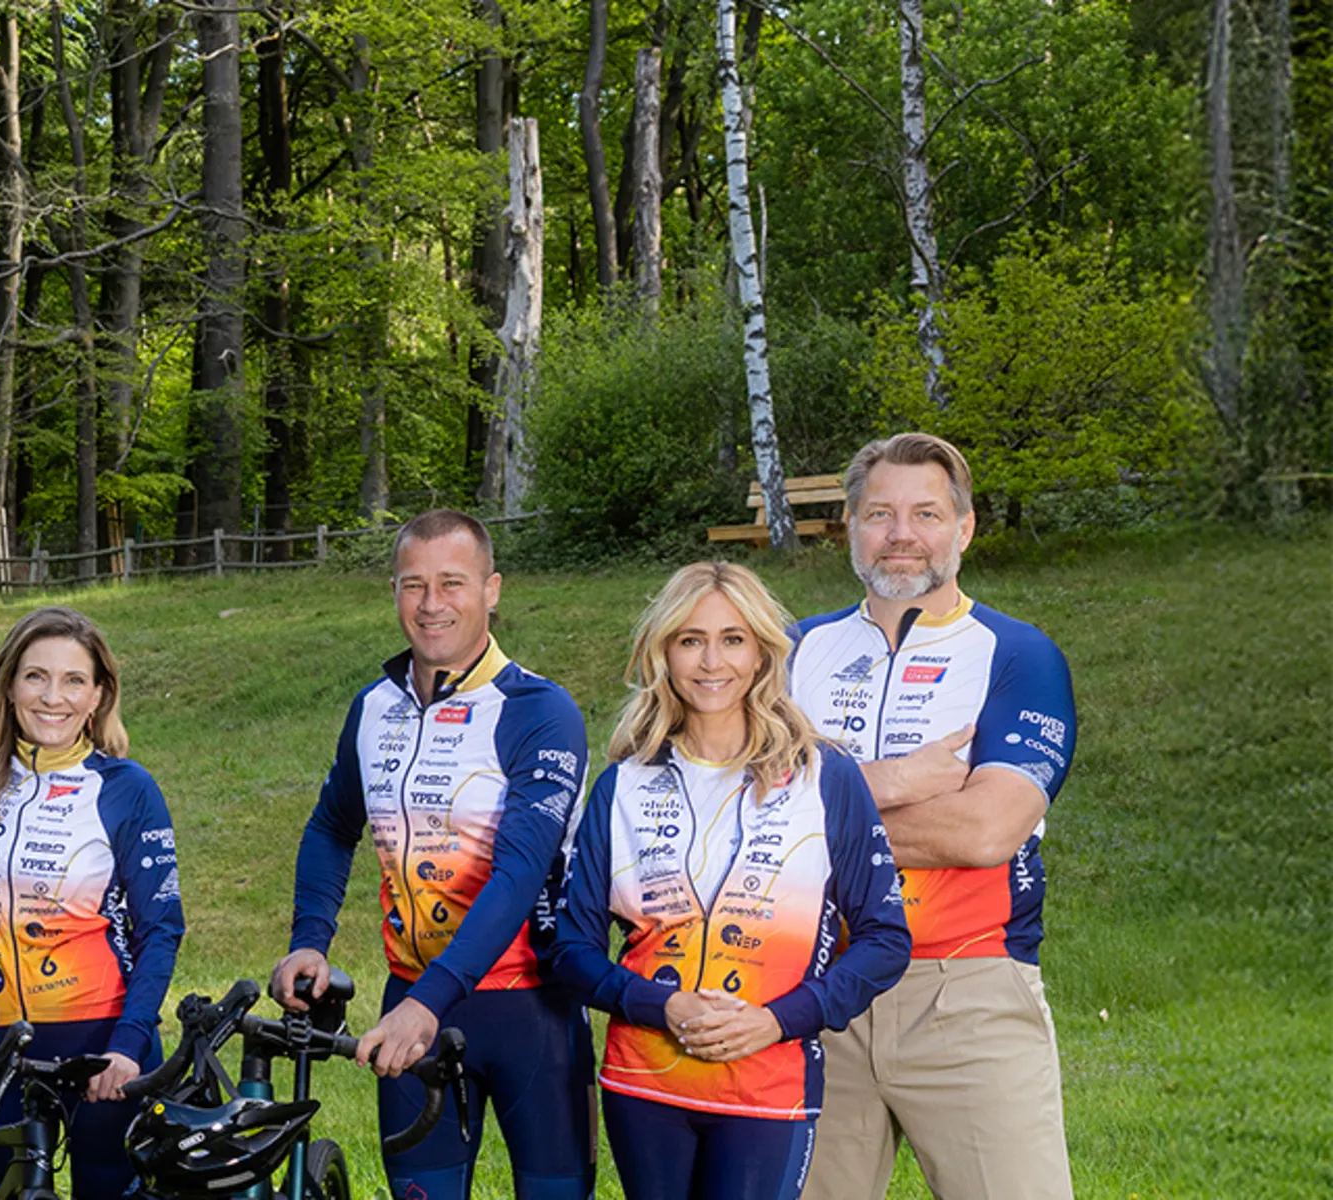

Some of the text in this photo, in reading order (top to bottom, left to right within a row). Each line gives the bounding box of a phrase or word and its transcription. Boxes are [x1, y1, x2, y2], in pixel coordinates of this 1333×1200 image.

[842, 715, 867, 733] 10
[1019, 709, 1067, 733] POWER
[383, 758, 401, 773] 10
[655, 824, 681, 839] 10
[431, 900, 449, 924] 6
[40, 955, 58, 977] 6
[722, 969, 742, 994] 6
